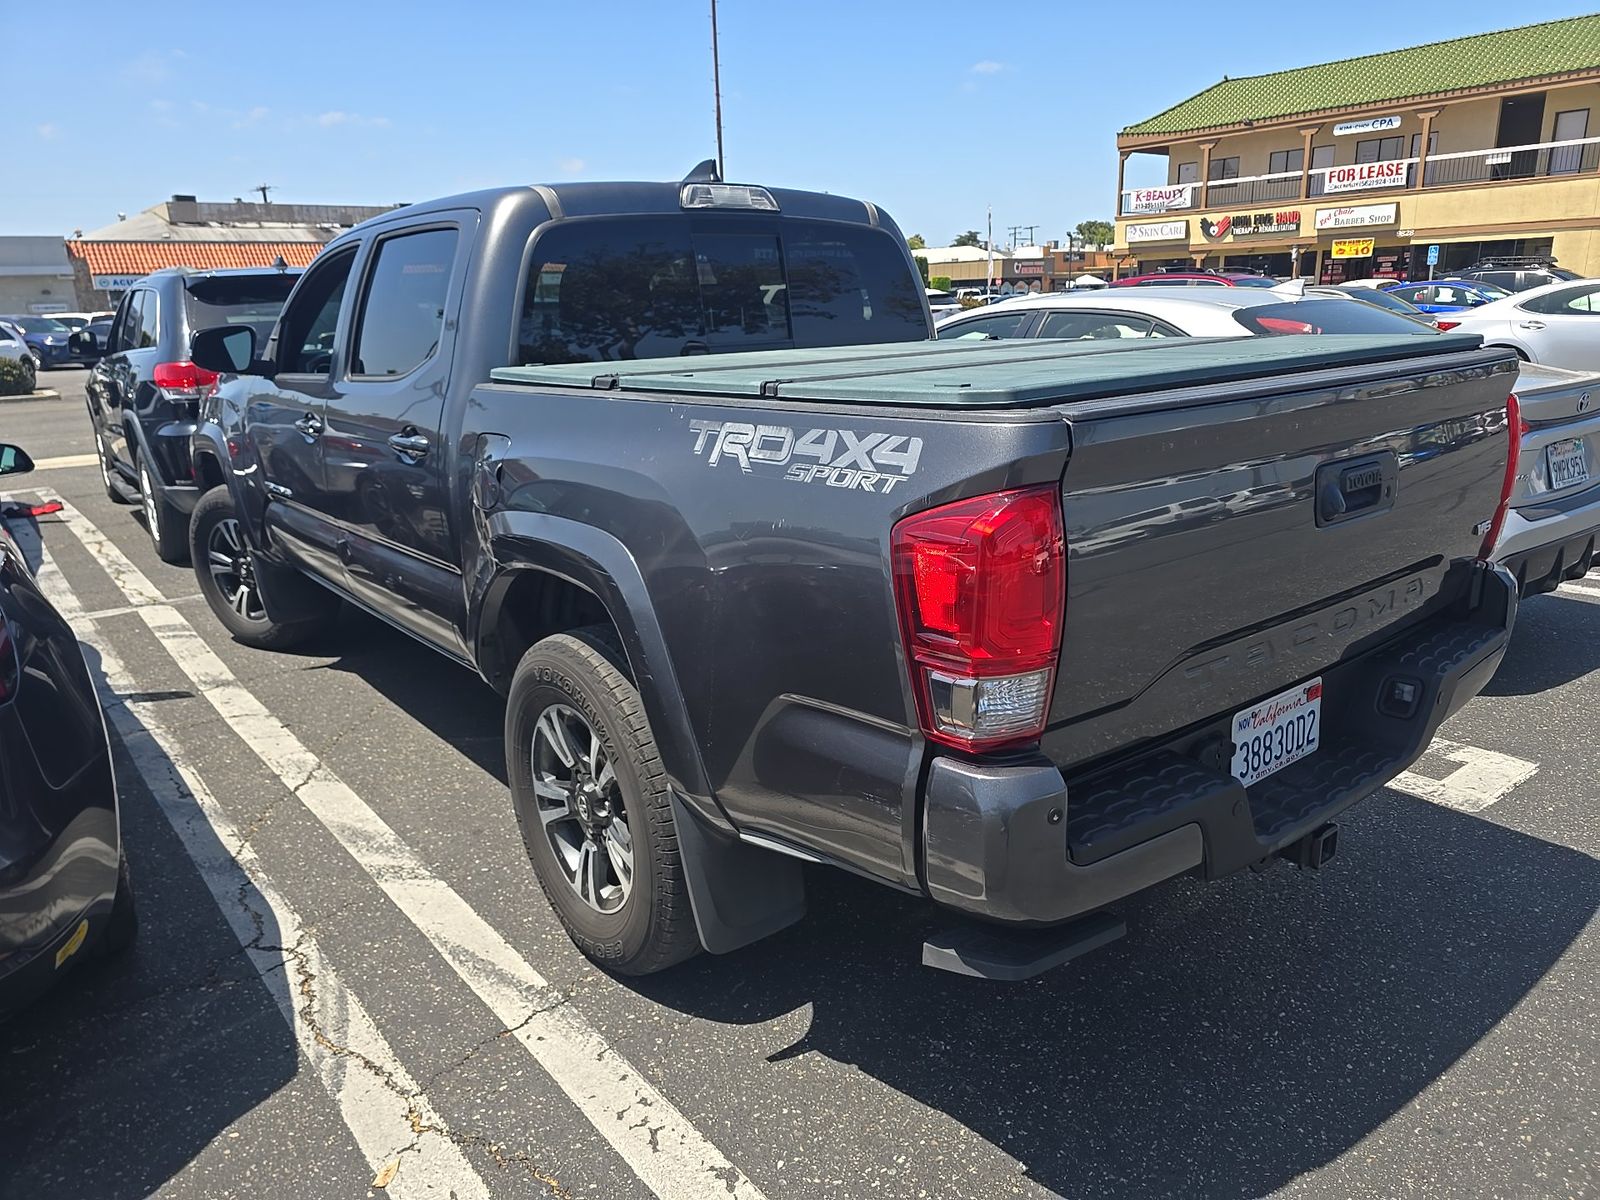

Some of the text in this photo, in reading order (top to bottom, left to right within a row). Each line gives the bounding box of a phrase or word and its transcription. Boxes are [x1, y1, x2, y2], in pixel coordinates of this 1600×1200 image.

[1372, 118, 1394, 129] CPA
[1328, 162, 1404, 184] FOR LEASE
[1135, 187, 1186, 203] K-BEAUTY
[1253, 213, 1274, 226] FIVE
[1275, 211, 1300, 224] HAND
[1319, 208, 1355, 227] Red Chair
[1334, 214, 1392, 226] BARBER SHOP
[1138, 224, 1185, 238] SKIN CARE
[1233, 226, 1253, 235] THERAPY
[113, 279, 137, 287] ACU
[689, 418, 796, 475] TRD
[783, 462, 910, 495] SPORT
[1184, 577, 1424, 691] TACOMA
[533, 665, 619, 765] YOKOHAMA
[1238, 696, 1306, 732] NOV California
[1239, 708, 1316, 779] 38830D2
[1255, 751, 1301, 779] dmv.ca.gov
